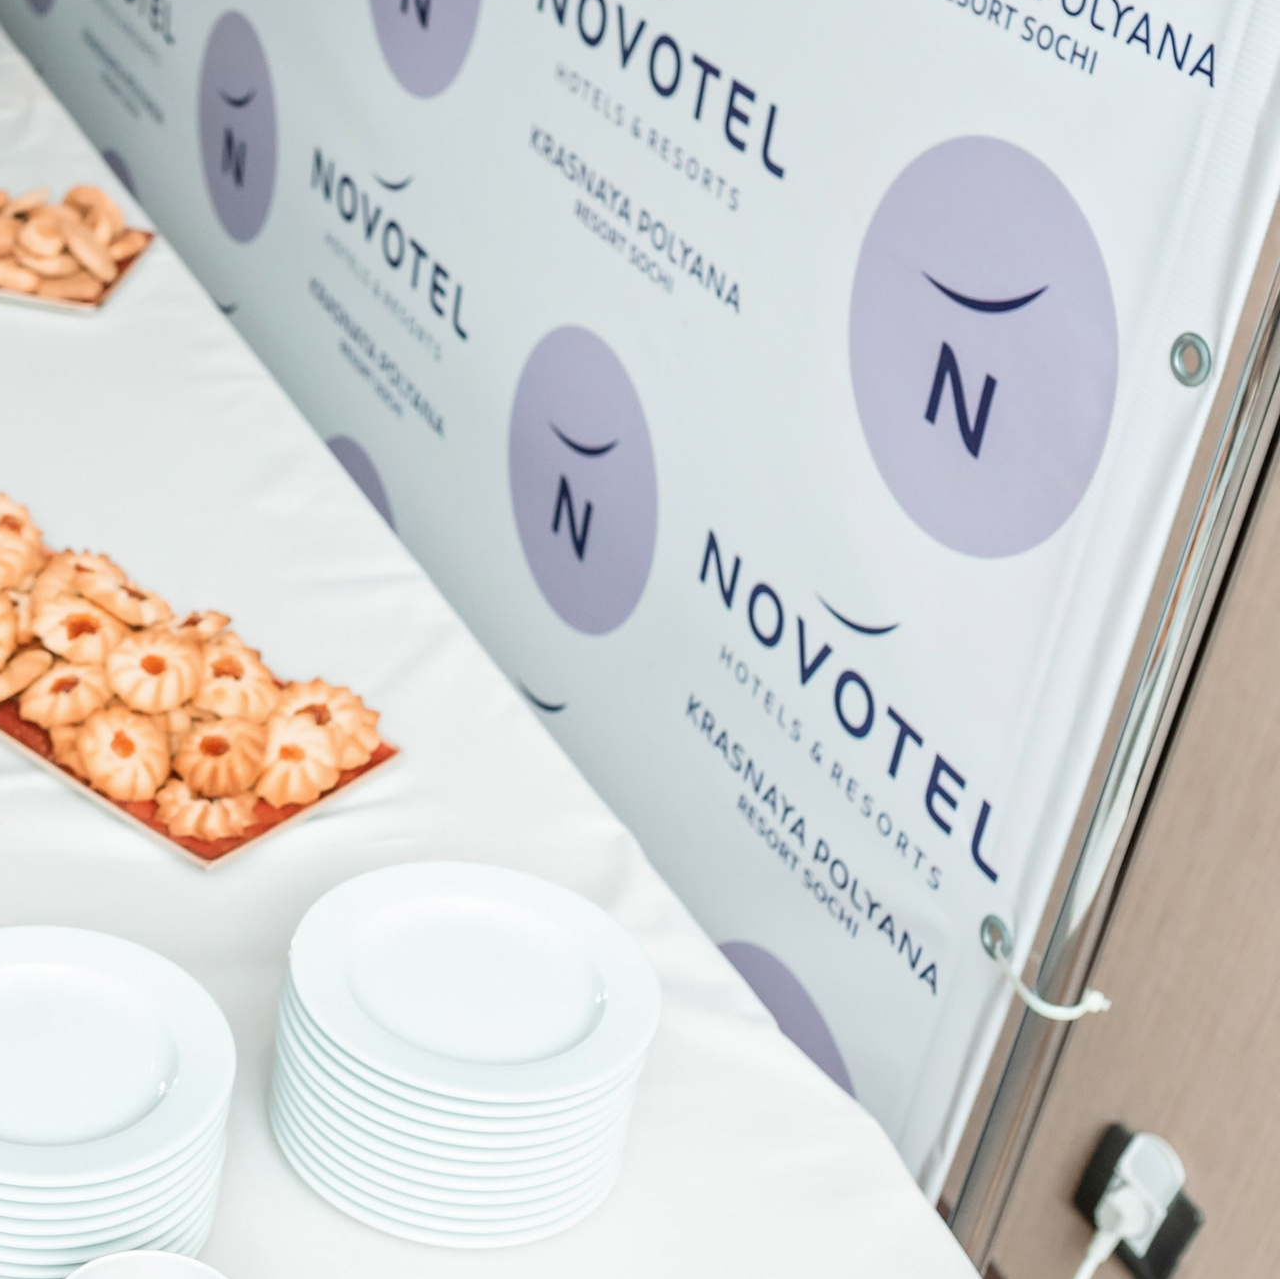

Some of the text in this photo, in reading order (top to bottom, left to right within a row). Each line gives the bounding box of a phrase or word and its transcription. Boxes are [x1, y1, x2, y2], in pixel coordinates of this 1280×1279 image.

[1020, 16, 1098, 75] SOCHI
[310, 147, 467, 341] NOVOTEL
[530, 124, 740, 314] KRASNAYA POLYANA
[647, 128, 740, 211] RESORTS
[924, 340, 997, 459] N
[552, 473, 593, 561] N
[699, 529, 999, 884] NOVOTEL
[719, 645, 802, 743] HOTELS
[830, 761, 943, 891] RESORTS
[685, 693, 937, 996] KRASNAYA POLYANA
[736, 793, 859, 938] RESORT SOCHI
